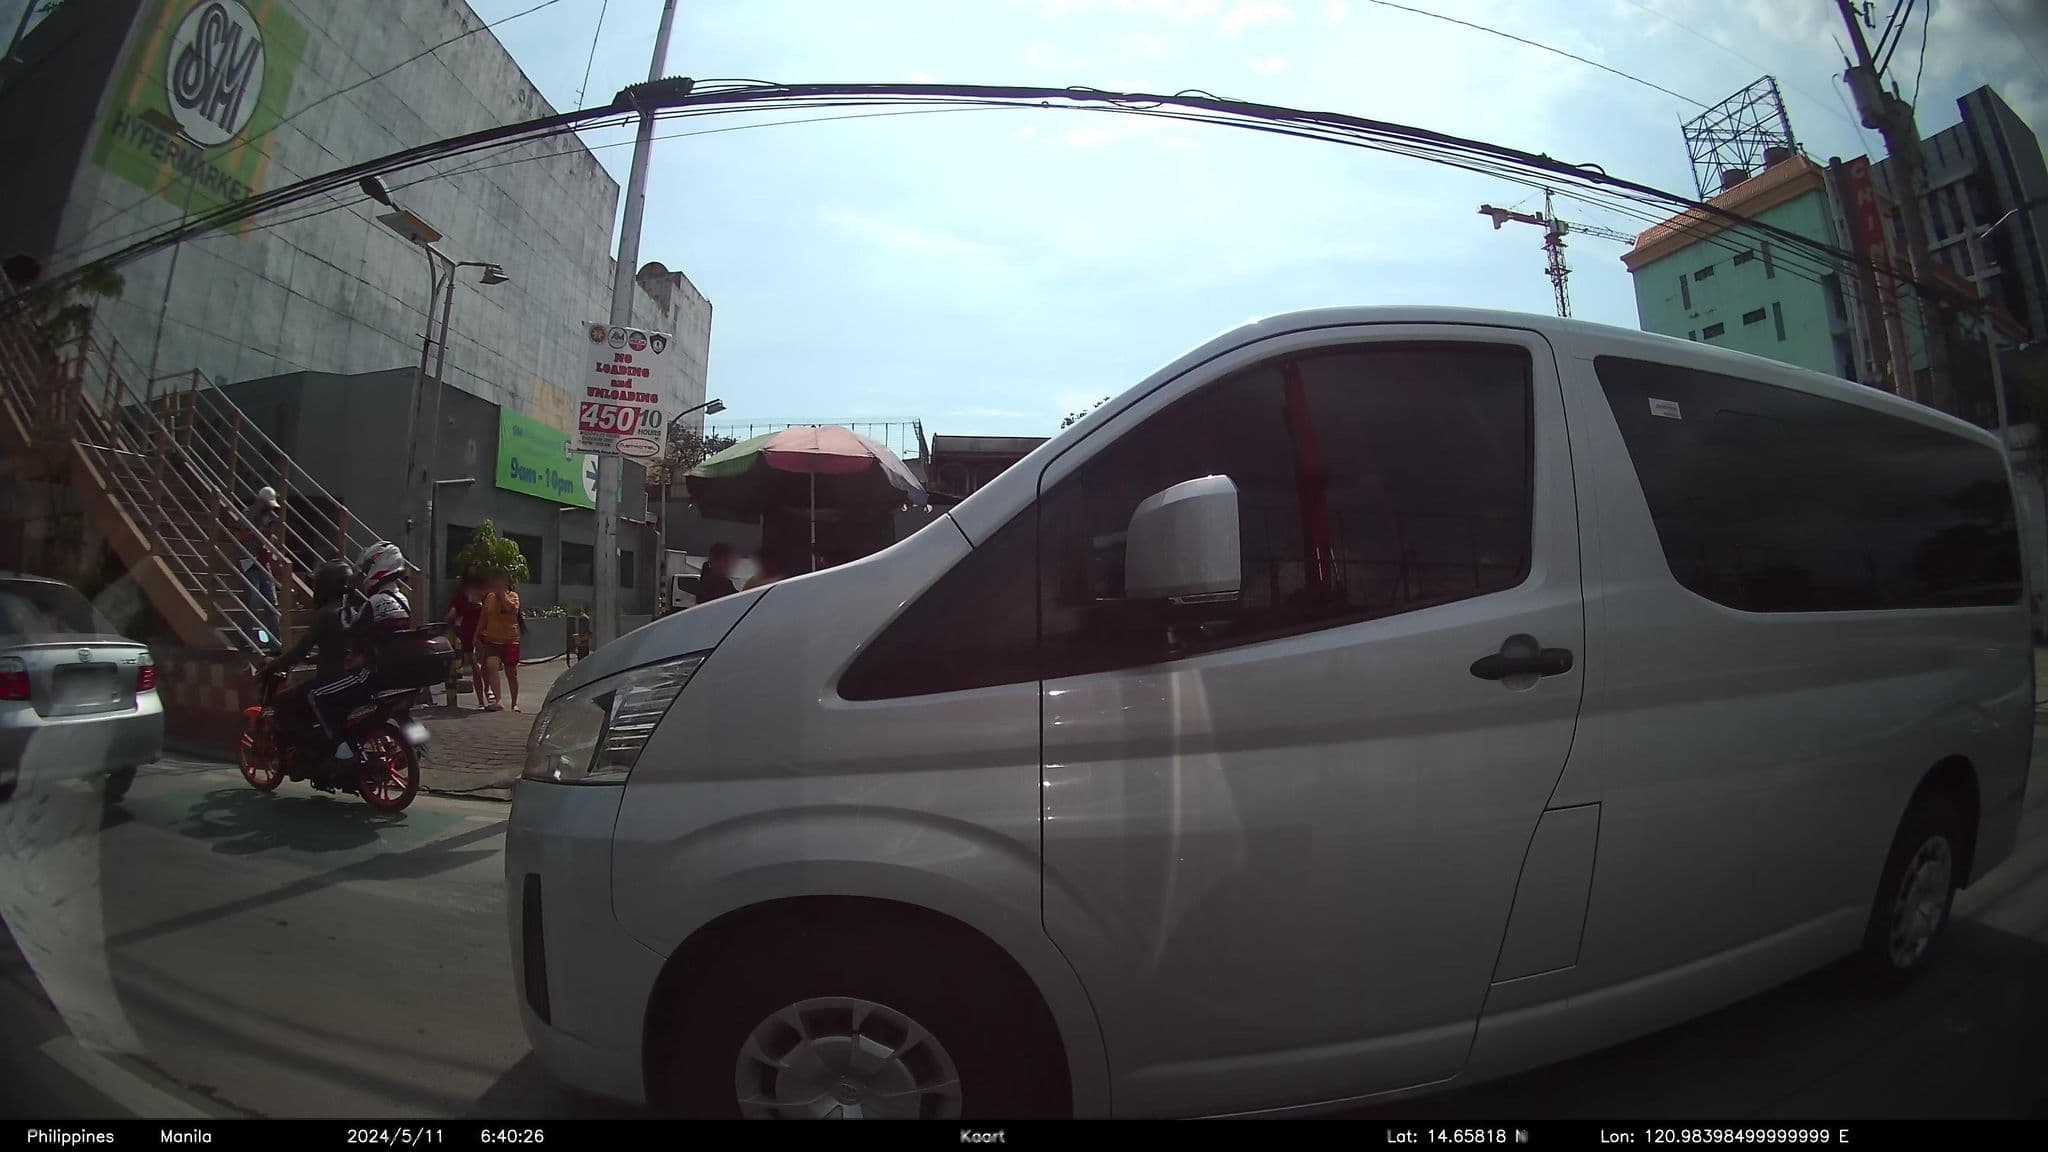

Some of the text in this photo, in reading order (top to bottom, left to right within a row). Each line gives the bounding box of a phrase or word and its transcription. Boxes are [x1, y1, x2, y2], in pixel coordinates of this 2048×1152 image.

[173, 3, 262, 135] SM
[614, 353, 633, 364] NO
[596, 362, 650, 378] LOADING
[610, 379, 633, 389] and
[587, 386, 659, 403] UNLOADING
[640, 409, 663, 428] 10
[510, 457, 537, 484] 9am
[545, 468, 574, 497] 10pm
